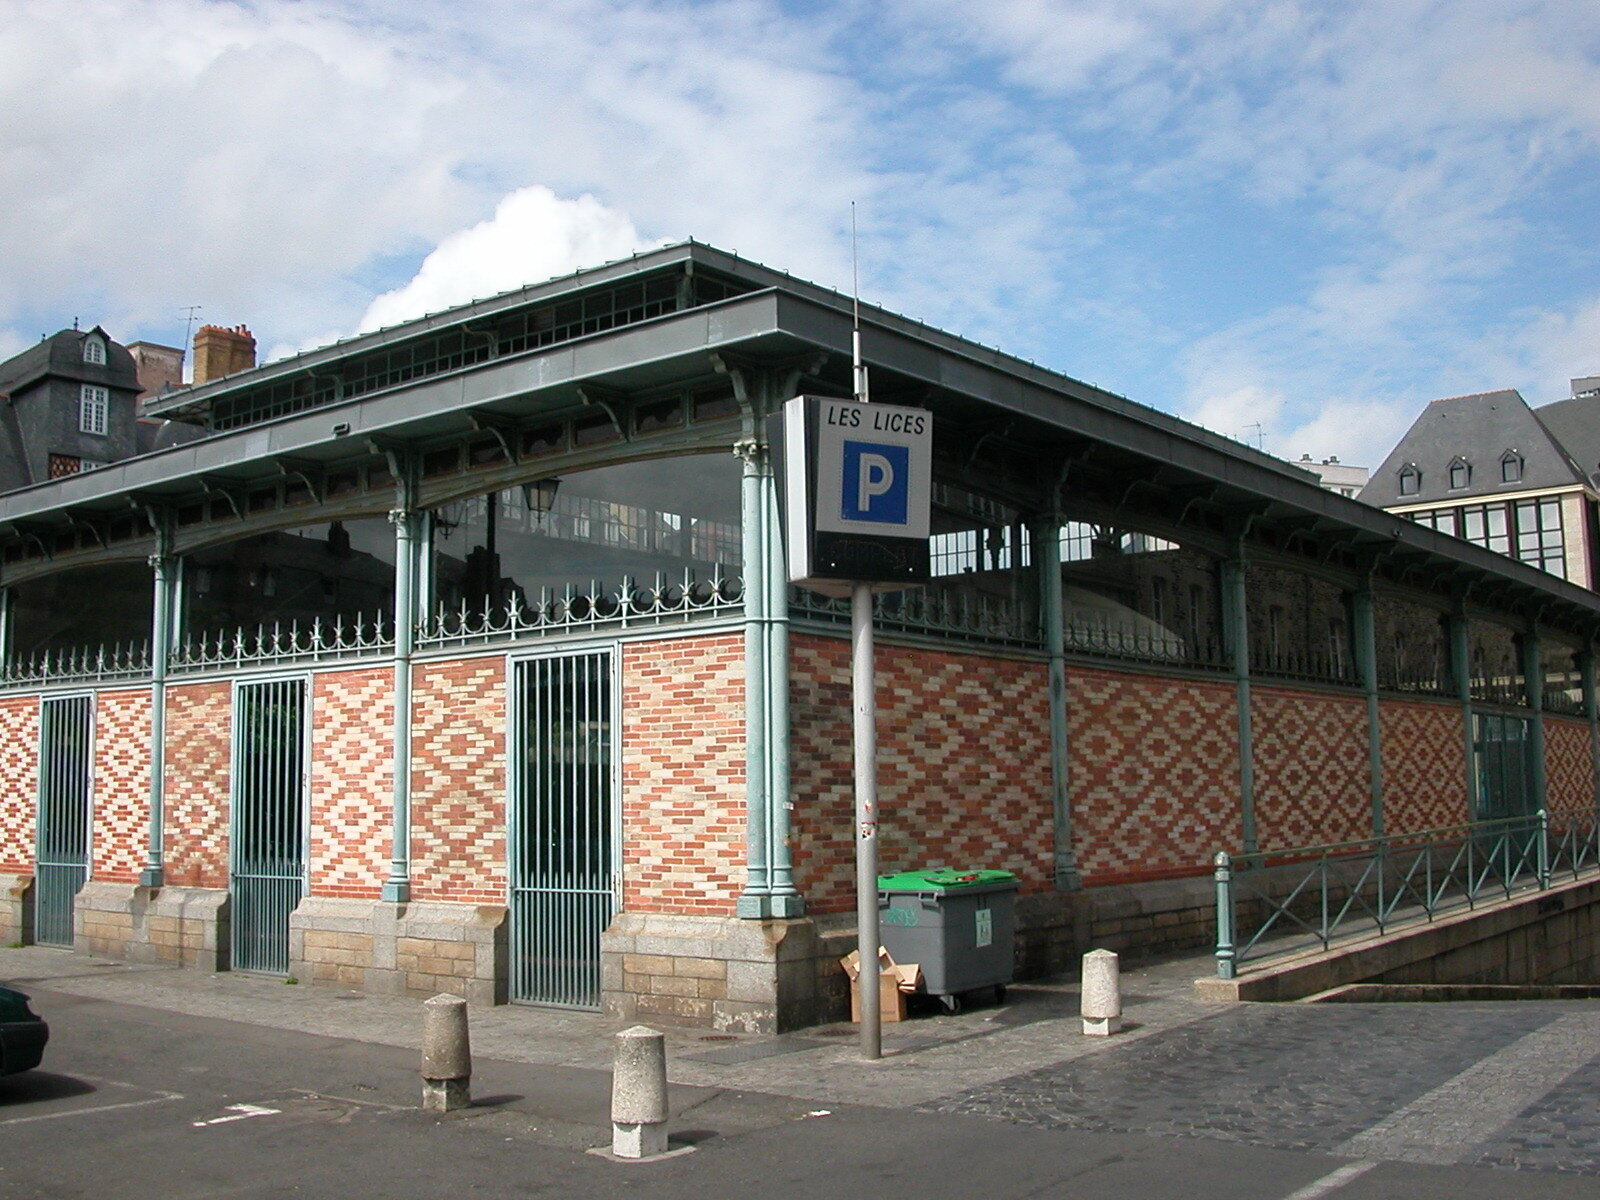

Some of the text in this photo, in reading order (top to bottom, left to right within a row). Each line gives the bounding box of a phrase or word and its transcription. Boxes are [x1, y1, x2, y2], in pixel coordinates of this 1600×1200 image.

[828, 405, 925, 435] LES LICES
[858, 452, 894, 512] P
